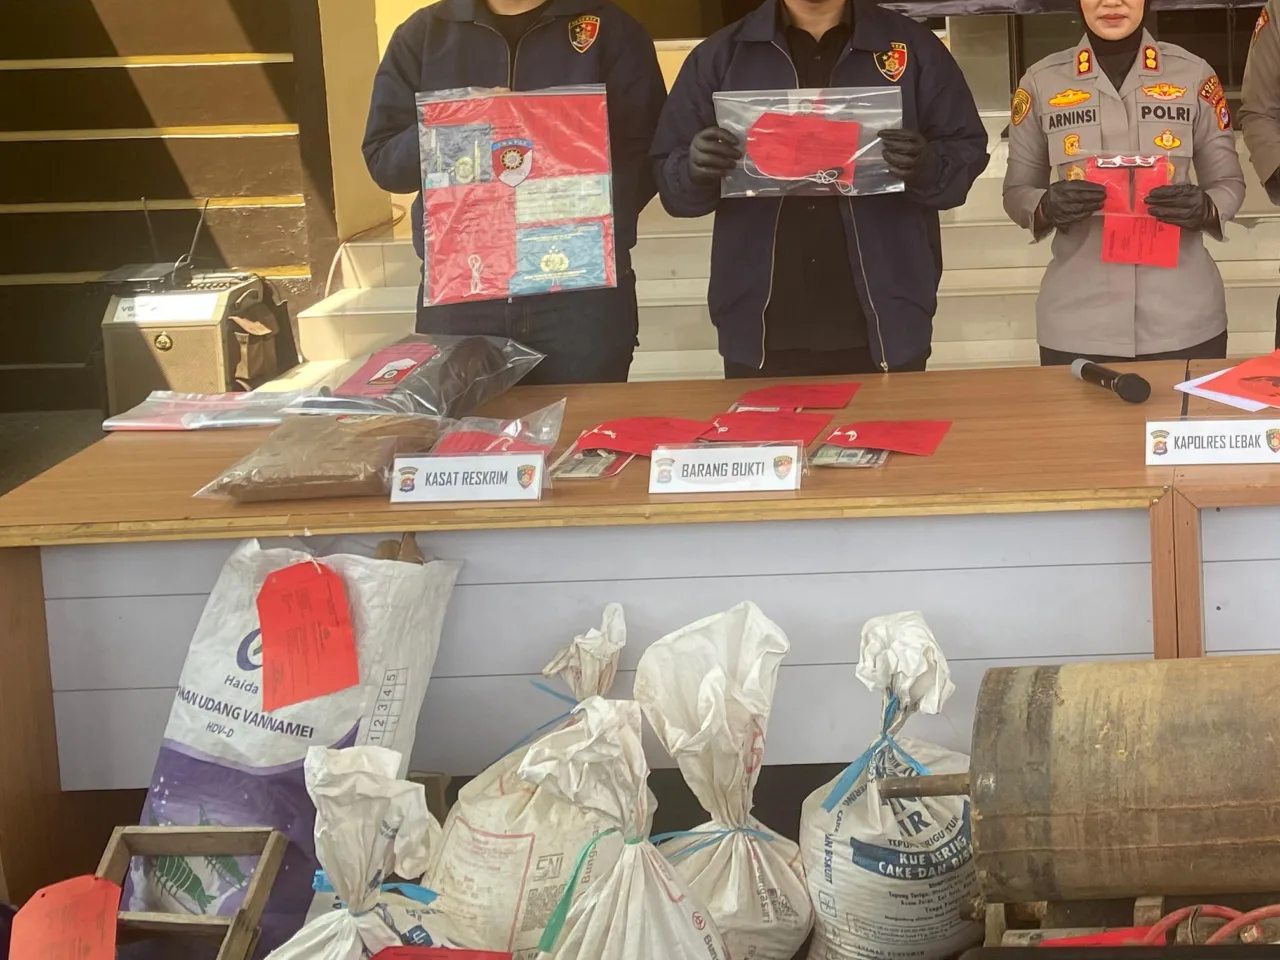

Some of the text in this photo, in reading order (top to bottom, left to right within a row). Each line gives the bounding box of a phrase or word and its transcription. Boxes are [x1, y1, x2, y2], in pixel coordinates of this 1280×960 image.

[1049, 109, 1097, 130] ARNINSI
[1141, 105, 1190, 122] POLRI
[1174, 434, 1261, 450] KAPOLRES LEBAK
[681, 462, 728, 478] BARANG
[731, 461, 765, 477] BUKTI
[425, 471, 459, 486] KASAT
[461, 471, 508, 486] RESKRIM
[224, 674, 260, 695] Haida
[373, 719, 384, 727] 2
[383, 689, 392, 697] 4
[198, 696, 241, 720] UDANG
[243, 709, 315, 738] VANNAMEI
[206, 721, 235, 738] HDV-D
[899, 852, 926, 865] KUE
[878, 861, 912, 879] CAKE
[918, 864, 947, 879] DAN
